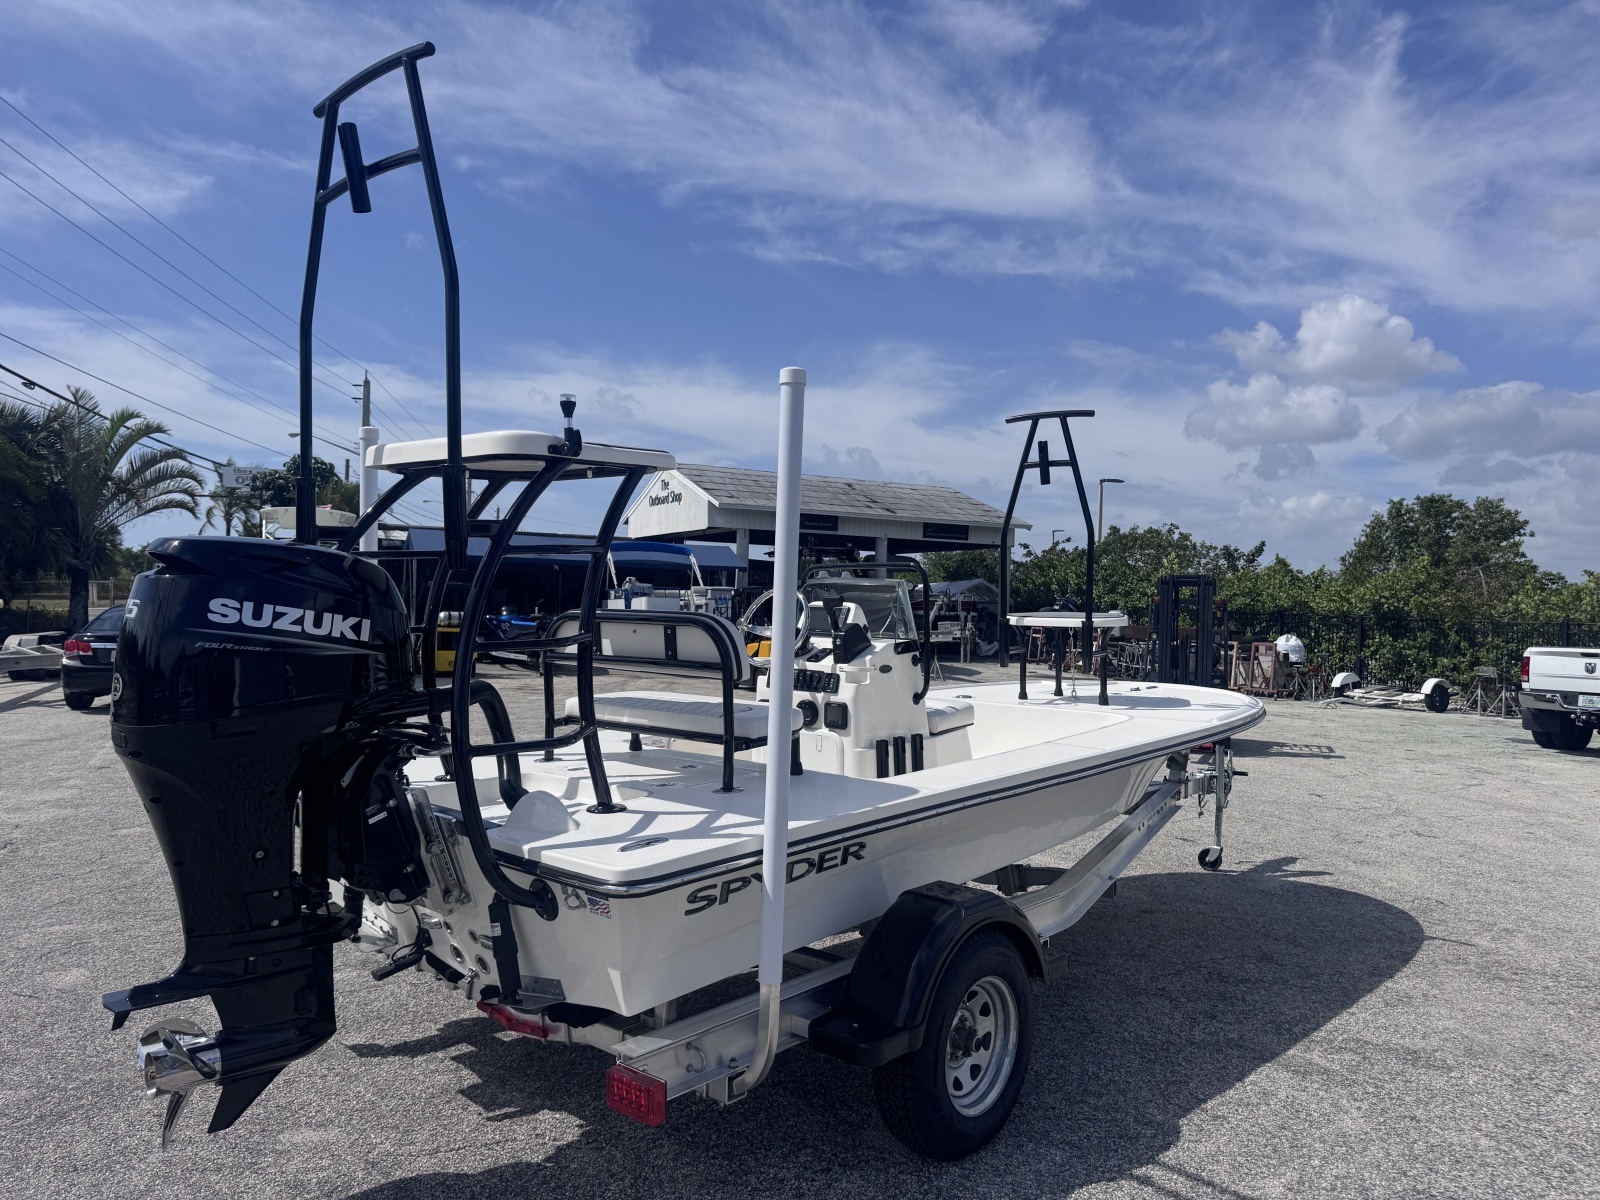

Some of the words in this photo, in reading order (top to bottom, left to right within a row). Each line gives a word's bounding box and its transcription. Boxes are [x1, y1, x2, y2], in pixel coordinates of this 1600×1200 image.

[661, 479, 670, 491] The
[649, 492, 670, 507] Outboard
[670, 490, 682, 506] Shop
[207, 597, 371, 642] SUZUKI
